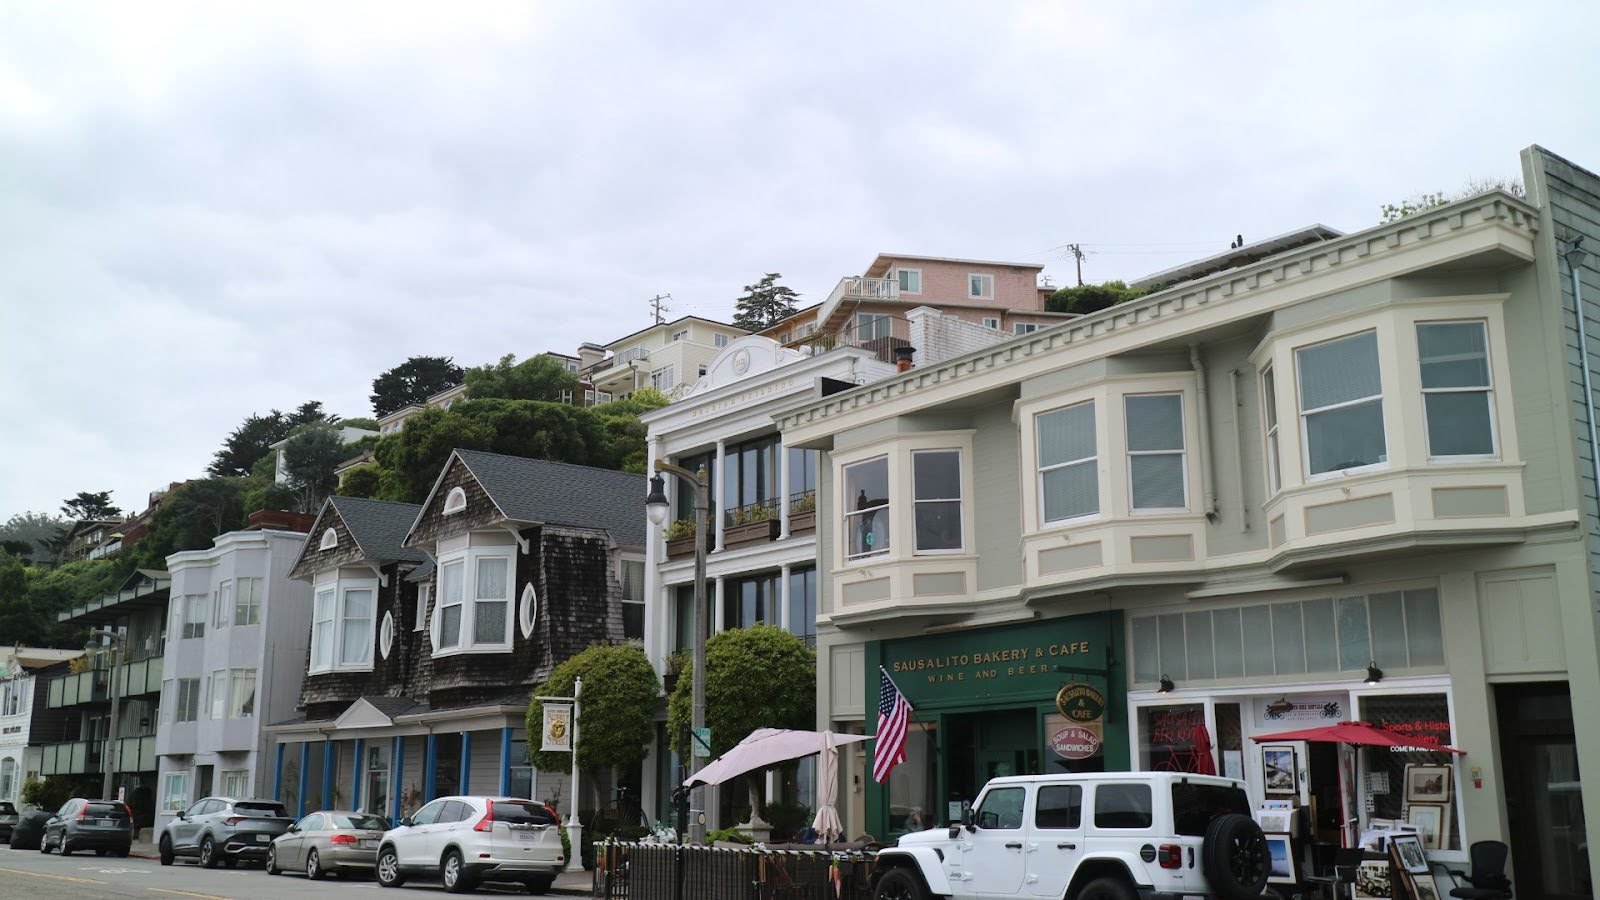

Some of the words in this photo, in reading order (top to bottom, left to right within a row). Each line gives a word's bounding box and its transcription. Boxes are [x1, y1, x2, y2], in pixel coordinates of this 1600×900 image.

[893, 655, 969, 672] SAUSALITO
[973, 648, 1029, 664] BAKERY
[1035, 648, 1044, 657] &
[1049, 641, 1089, 656] CAFE
[928, 672, 964, 682] WINE
[975, 669, 997, 679] AND
[1072, 710, 1092, 719] CAFE
[1383, 721, 1414, 734] Sports
[1053, 730, 1069, 744] SOUP
[1078, 730, 1097, 746] SALAD
[1056, 744, 1095, 753] SANDWICHES
[1390, 745, 1409, 753] COME
